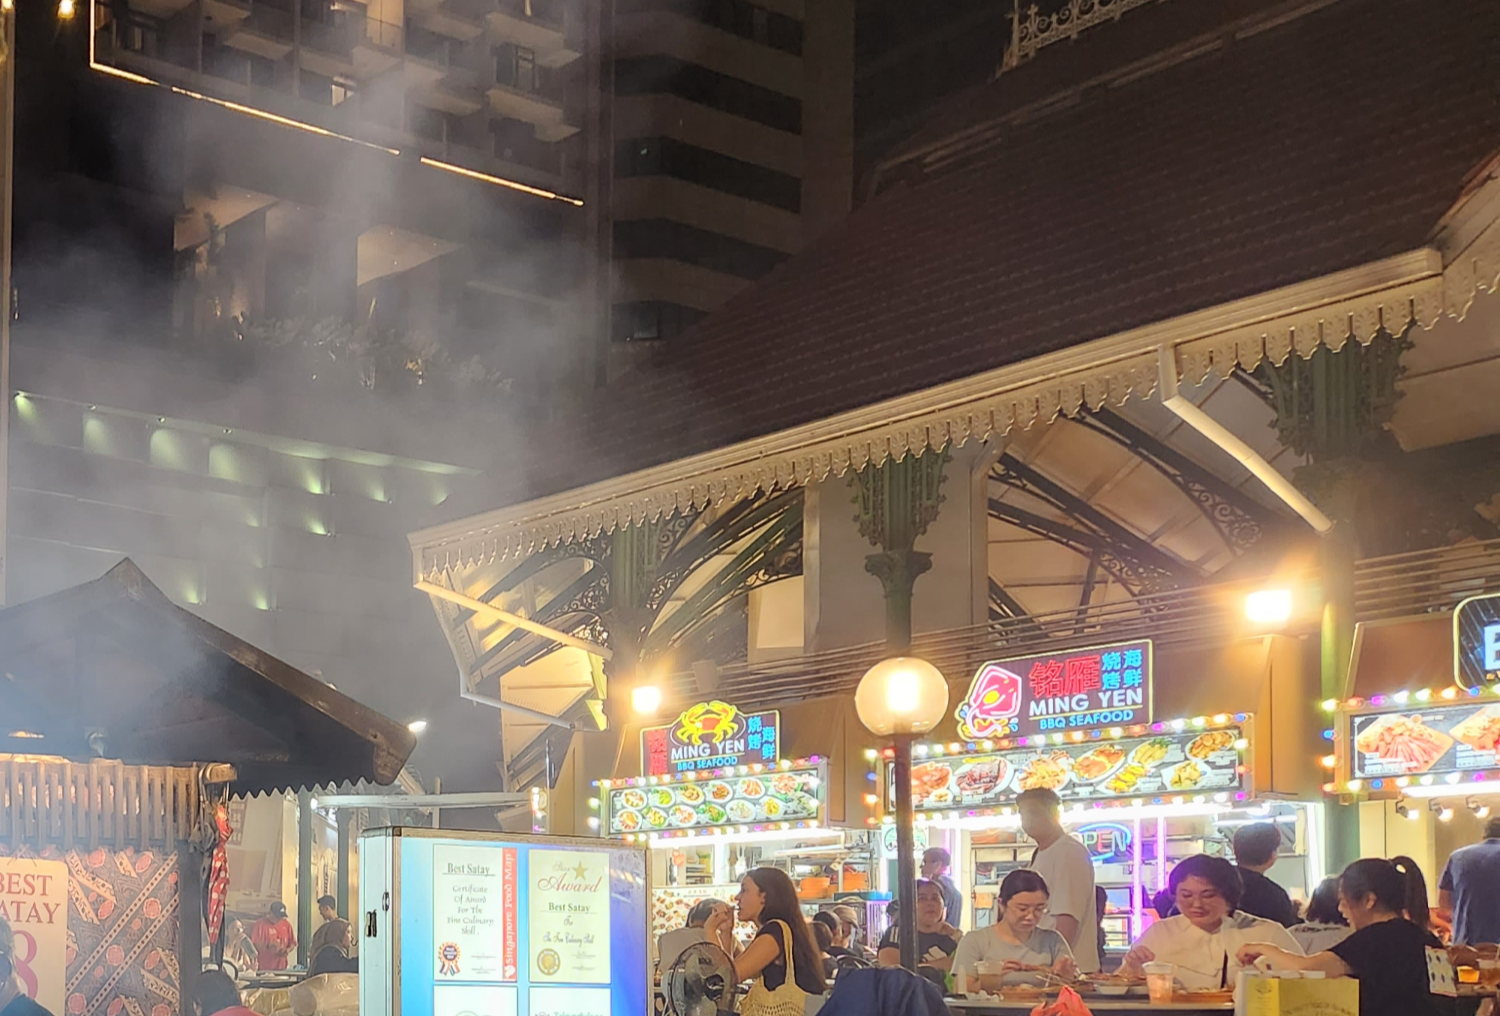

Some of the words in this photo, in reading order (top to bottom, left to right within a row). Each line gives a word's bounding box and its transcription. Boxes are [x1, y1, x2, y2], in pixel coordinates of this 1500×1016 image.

[1029, 654, 1101, 699] 铭雁
[1029, 693, 1090, 717] MING
[1098, 688, 1143, 709] YEN
[1039, 716, 1066, 730] BBQ
[1069, 710, 1134, 727] SEAFOOD
[671, 743, 711, 760] MING
[716, 739, 745, 754] YEN
[677, 760, 695, 771] BBQ
[696, 756, 738, 769] SEAFOOD
[447, 863, 465, 874] Best
[467, 864, 490, 877] Satay
[504, 853, 515, 880] Map
[537, 872, 603, 893] Award
[504, 884, 514, 908] Food
[548, 902, 566, 911] Best
[567, 902, 590, 914] Satay
[504, 911, 515, 964] Singapore
